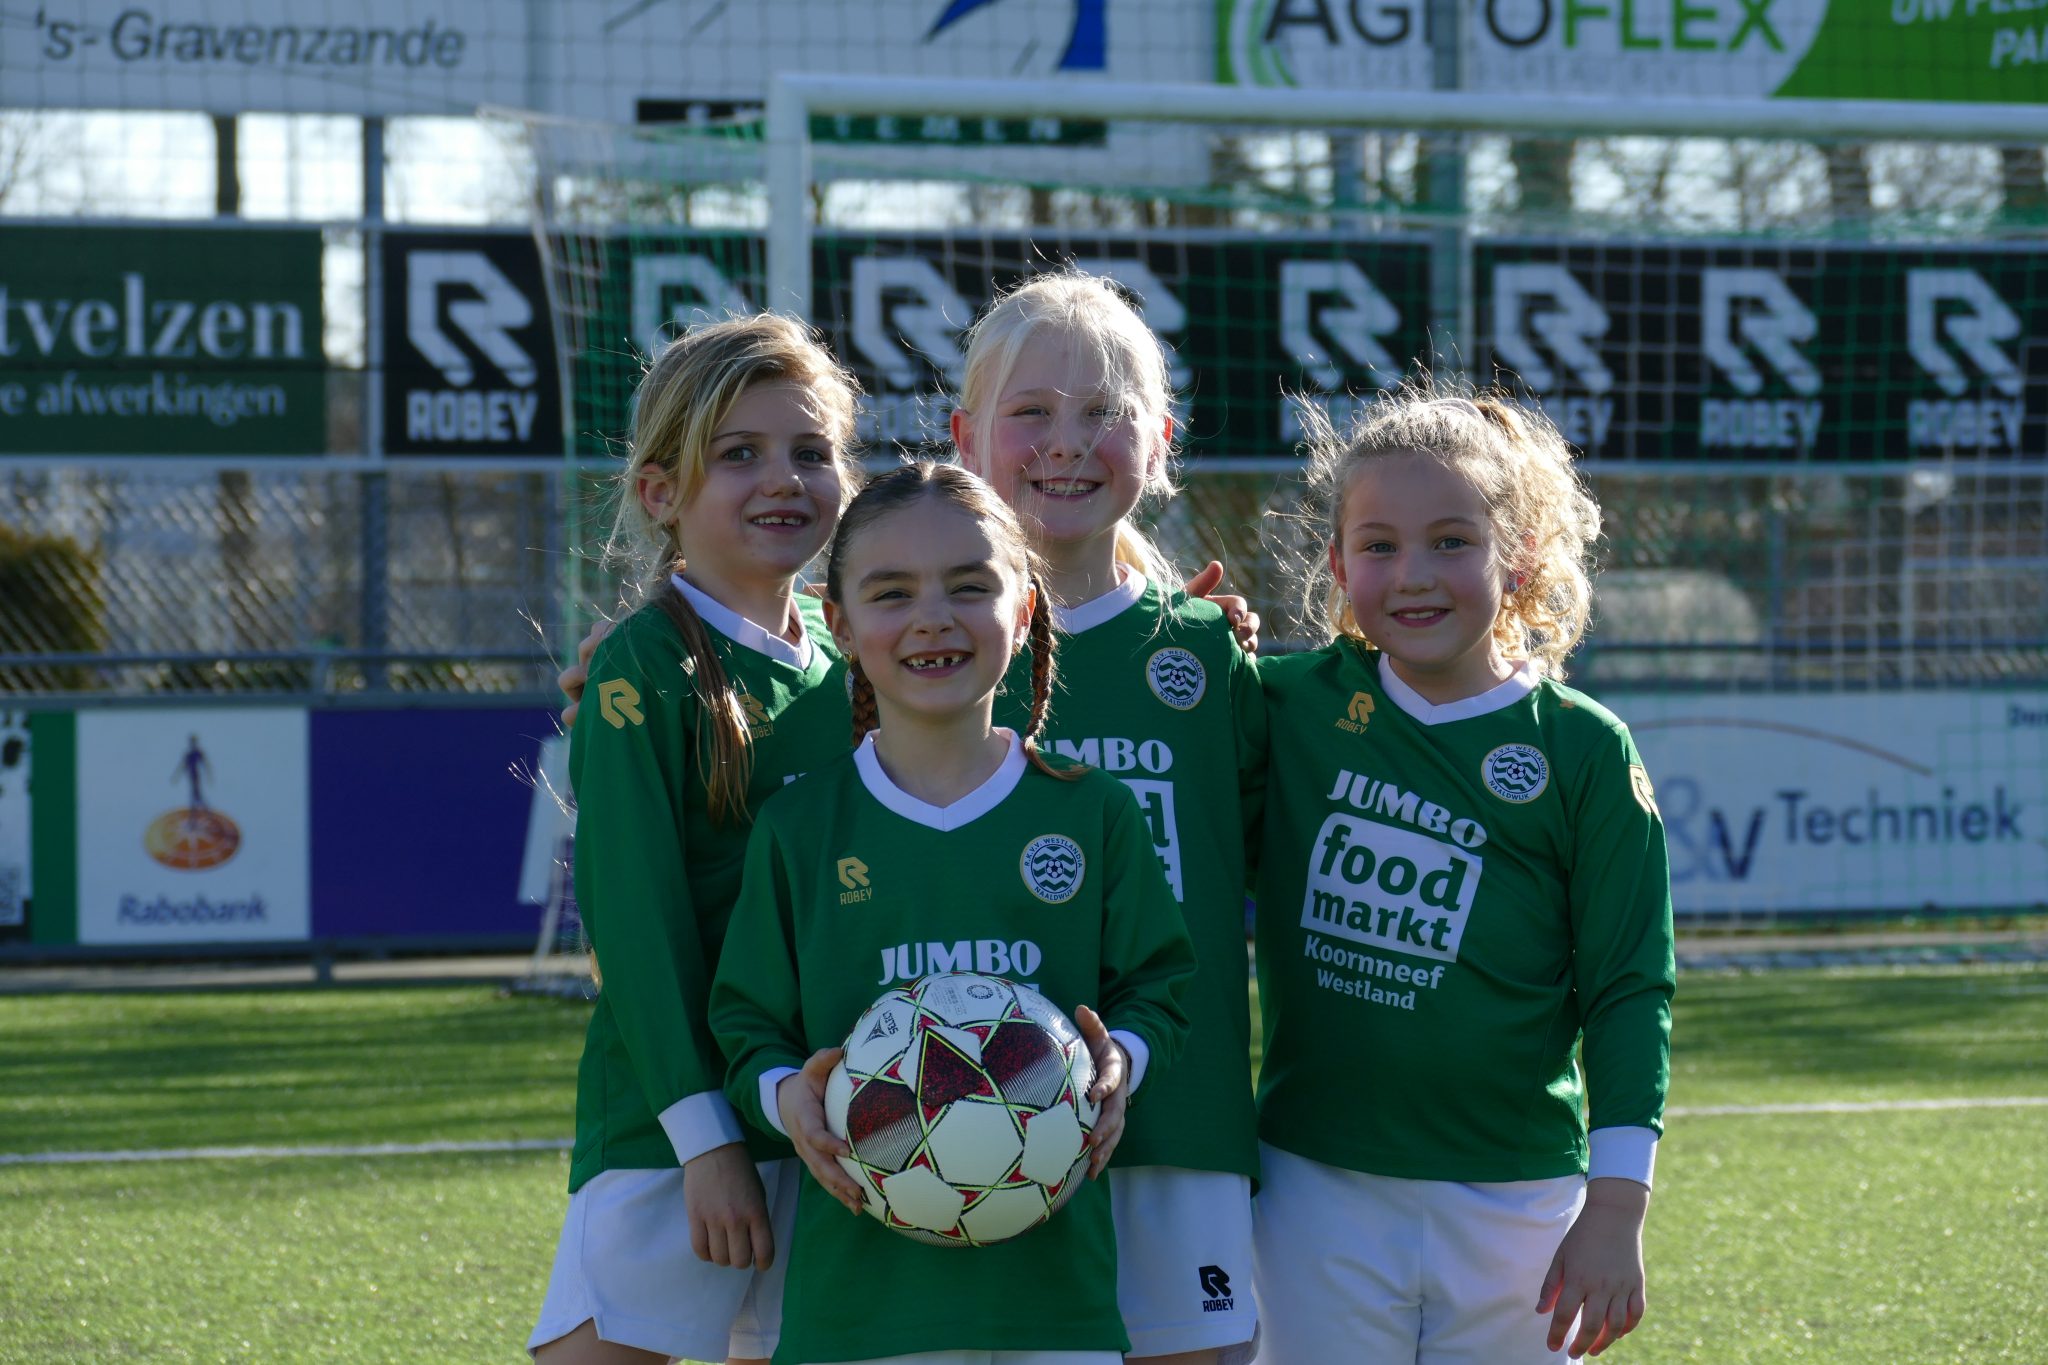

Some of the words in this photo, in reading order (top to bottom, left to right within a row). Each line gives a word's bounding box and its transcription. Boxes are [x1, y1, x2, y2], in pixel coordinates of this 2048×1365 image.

[406, 390, 538, 442] ROBEY
[1702, 399, 1824, 448] ROBEY
[1907, 399, 2025, 448] ROBEY
[752, 721, 775, 739] OBEY
[1335, 718, 1368, 735] ROBEY
[1326, 769, 1487, 848] JUMBO
[1777, 783, 2024, 845] Techniek
[1043, 837, 1083, 868] WESTLANDIA
[1318, 823, 1469, 912] food
[118, 892, 269, 926] Rabobank
[840, 887, 872, 906] ROBEY
[1034, 886, 1074, 901] NAALDWIJK
[1312, 887, 1452, 952] markt
[878, 939, 1042, 986] JUMBO
[1304, 934, 1445, 990] Koornneef
[1317, 967, 1416, 1011] Westland
[882, 1009, 900, 1036] SELECT
[1202, 1298, 1234, 1313] ROBEY
